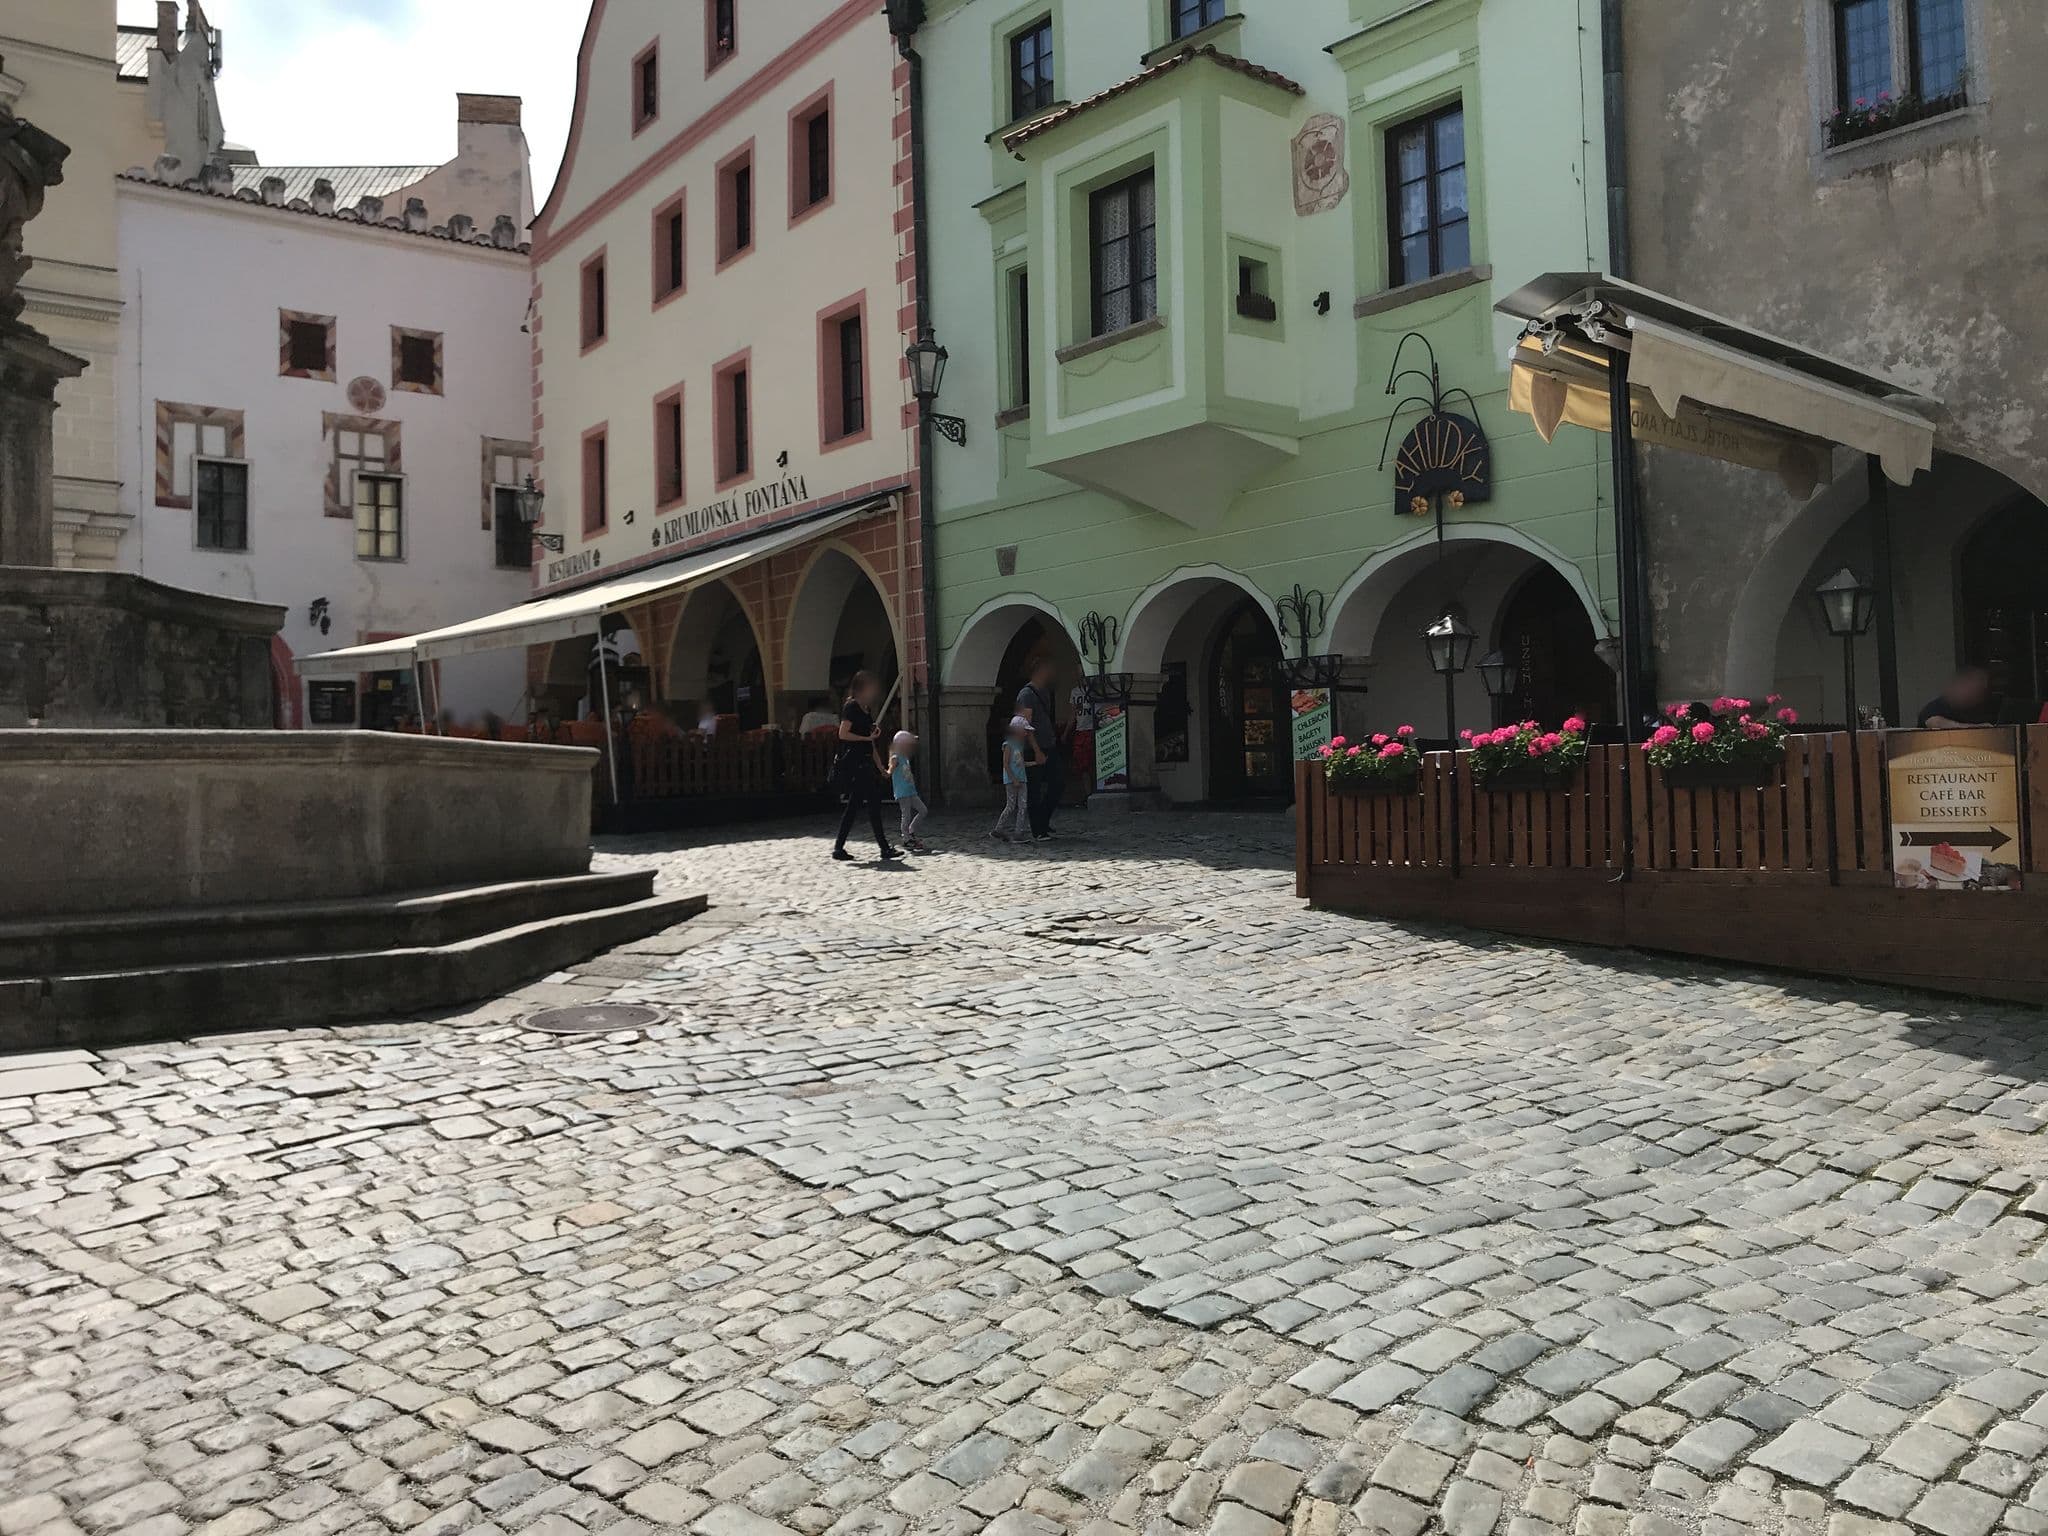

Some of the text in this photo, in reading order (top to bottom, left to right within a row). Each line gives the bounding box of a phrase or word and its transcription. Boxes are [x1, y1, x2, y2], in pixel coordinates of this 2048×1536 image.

[664, 473, 809, 545] KRUMLOVSKÁ FONTÁNA
[1298, 727, 1321, 743] BAGETY
[1907, 772, 1997, 784] RESTAURANT
[1920, 788, 1986, 801] CAFÉ BAR
[1920, 806, 1987, 817] DESSERTS
